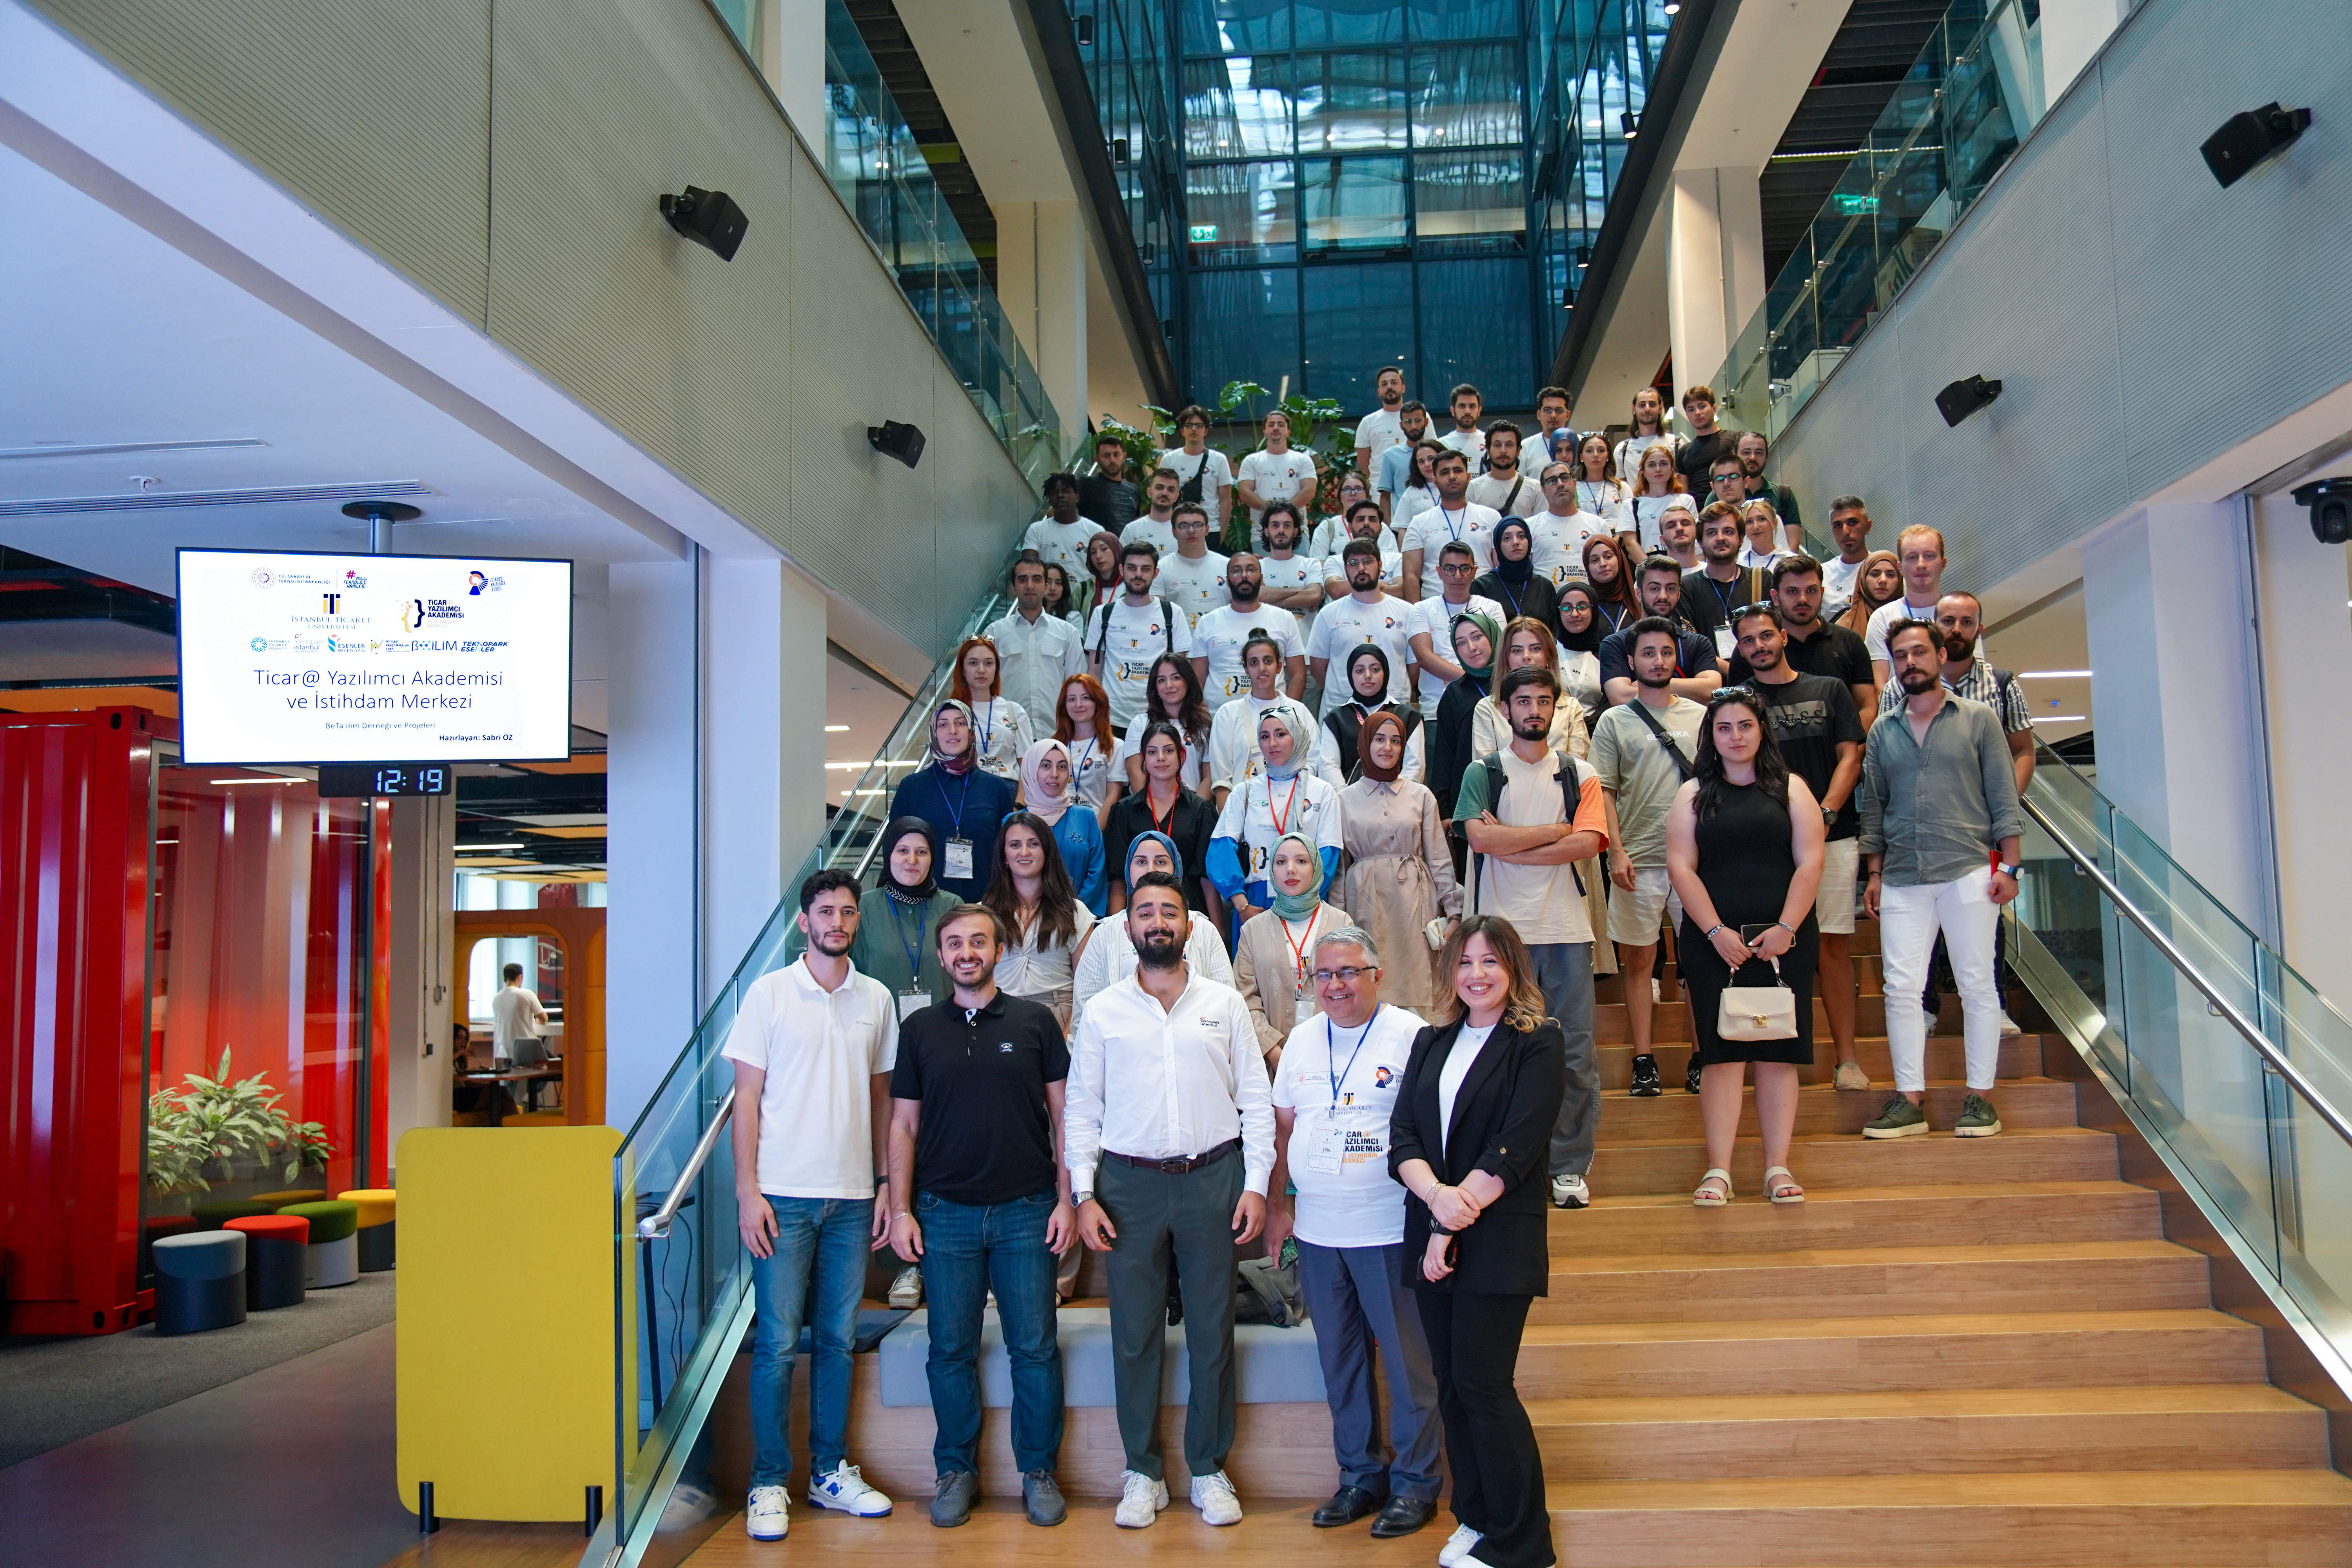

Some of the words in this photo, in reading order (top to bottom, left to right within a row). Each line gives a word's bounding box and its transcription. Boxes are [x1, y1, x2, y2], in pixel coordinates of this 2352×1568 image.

[254, 670, 319, 687] Ticar@
[328, 670, 404, 685] Yazılımcı
[412, 670, 503, 685] Akademisi
[287, 697, 307, 709] ve
[316, 691, 394, 709] İstihdam
[402, 693, 472, 709] Merkezi
[1646, 731, 1690, 740] BEHKA
[376, 769, 443, 793] 12:19
